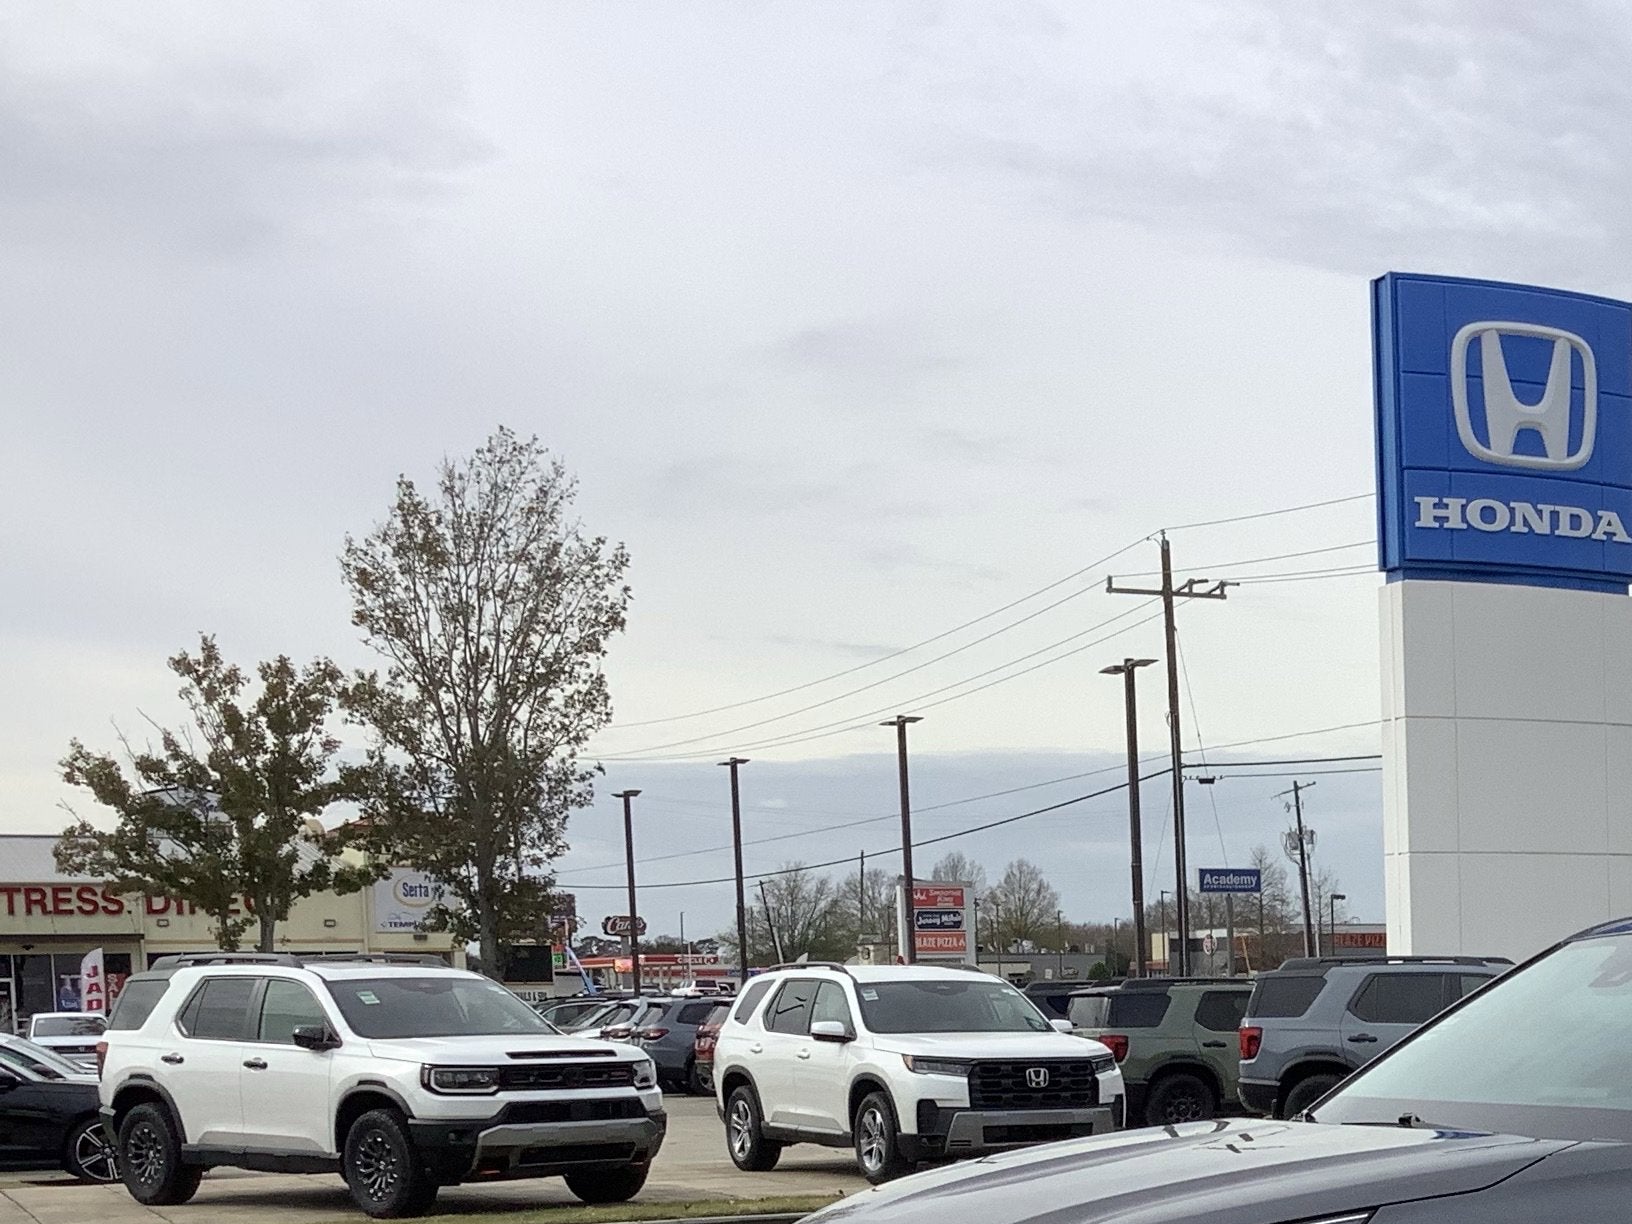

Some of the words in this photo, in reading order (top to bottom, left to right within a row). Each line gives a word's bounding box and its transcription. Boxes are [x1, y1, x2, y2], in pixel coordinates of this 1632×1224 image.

[1414, 496, 1632, 544] HONDA
[1203, 872, 1257, 888] Academy
[402, 882, 429, 897] Serta
